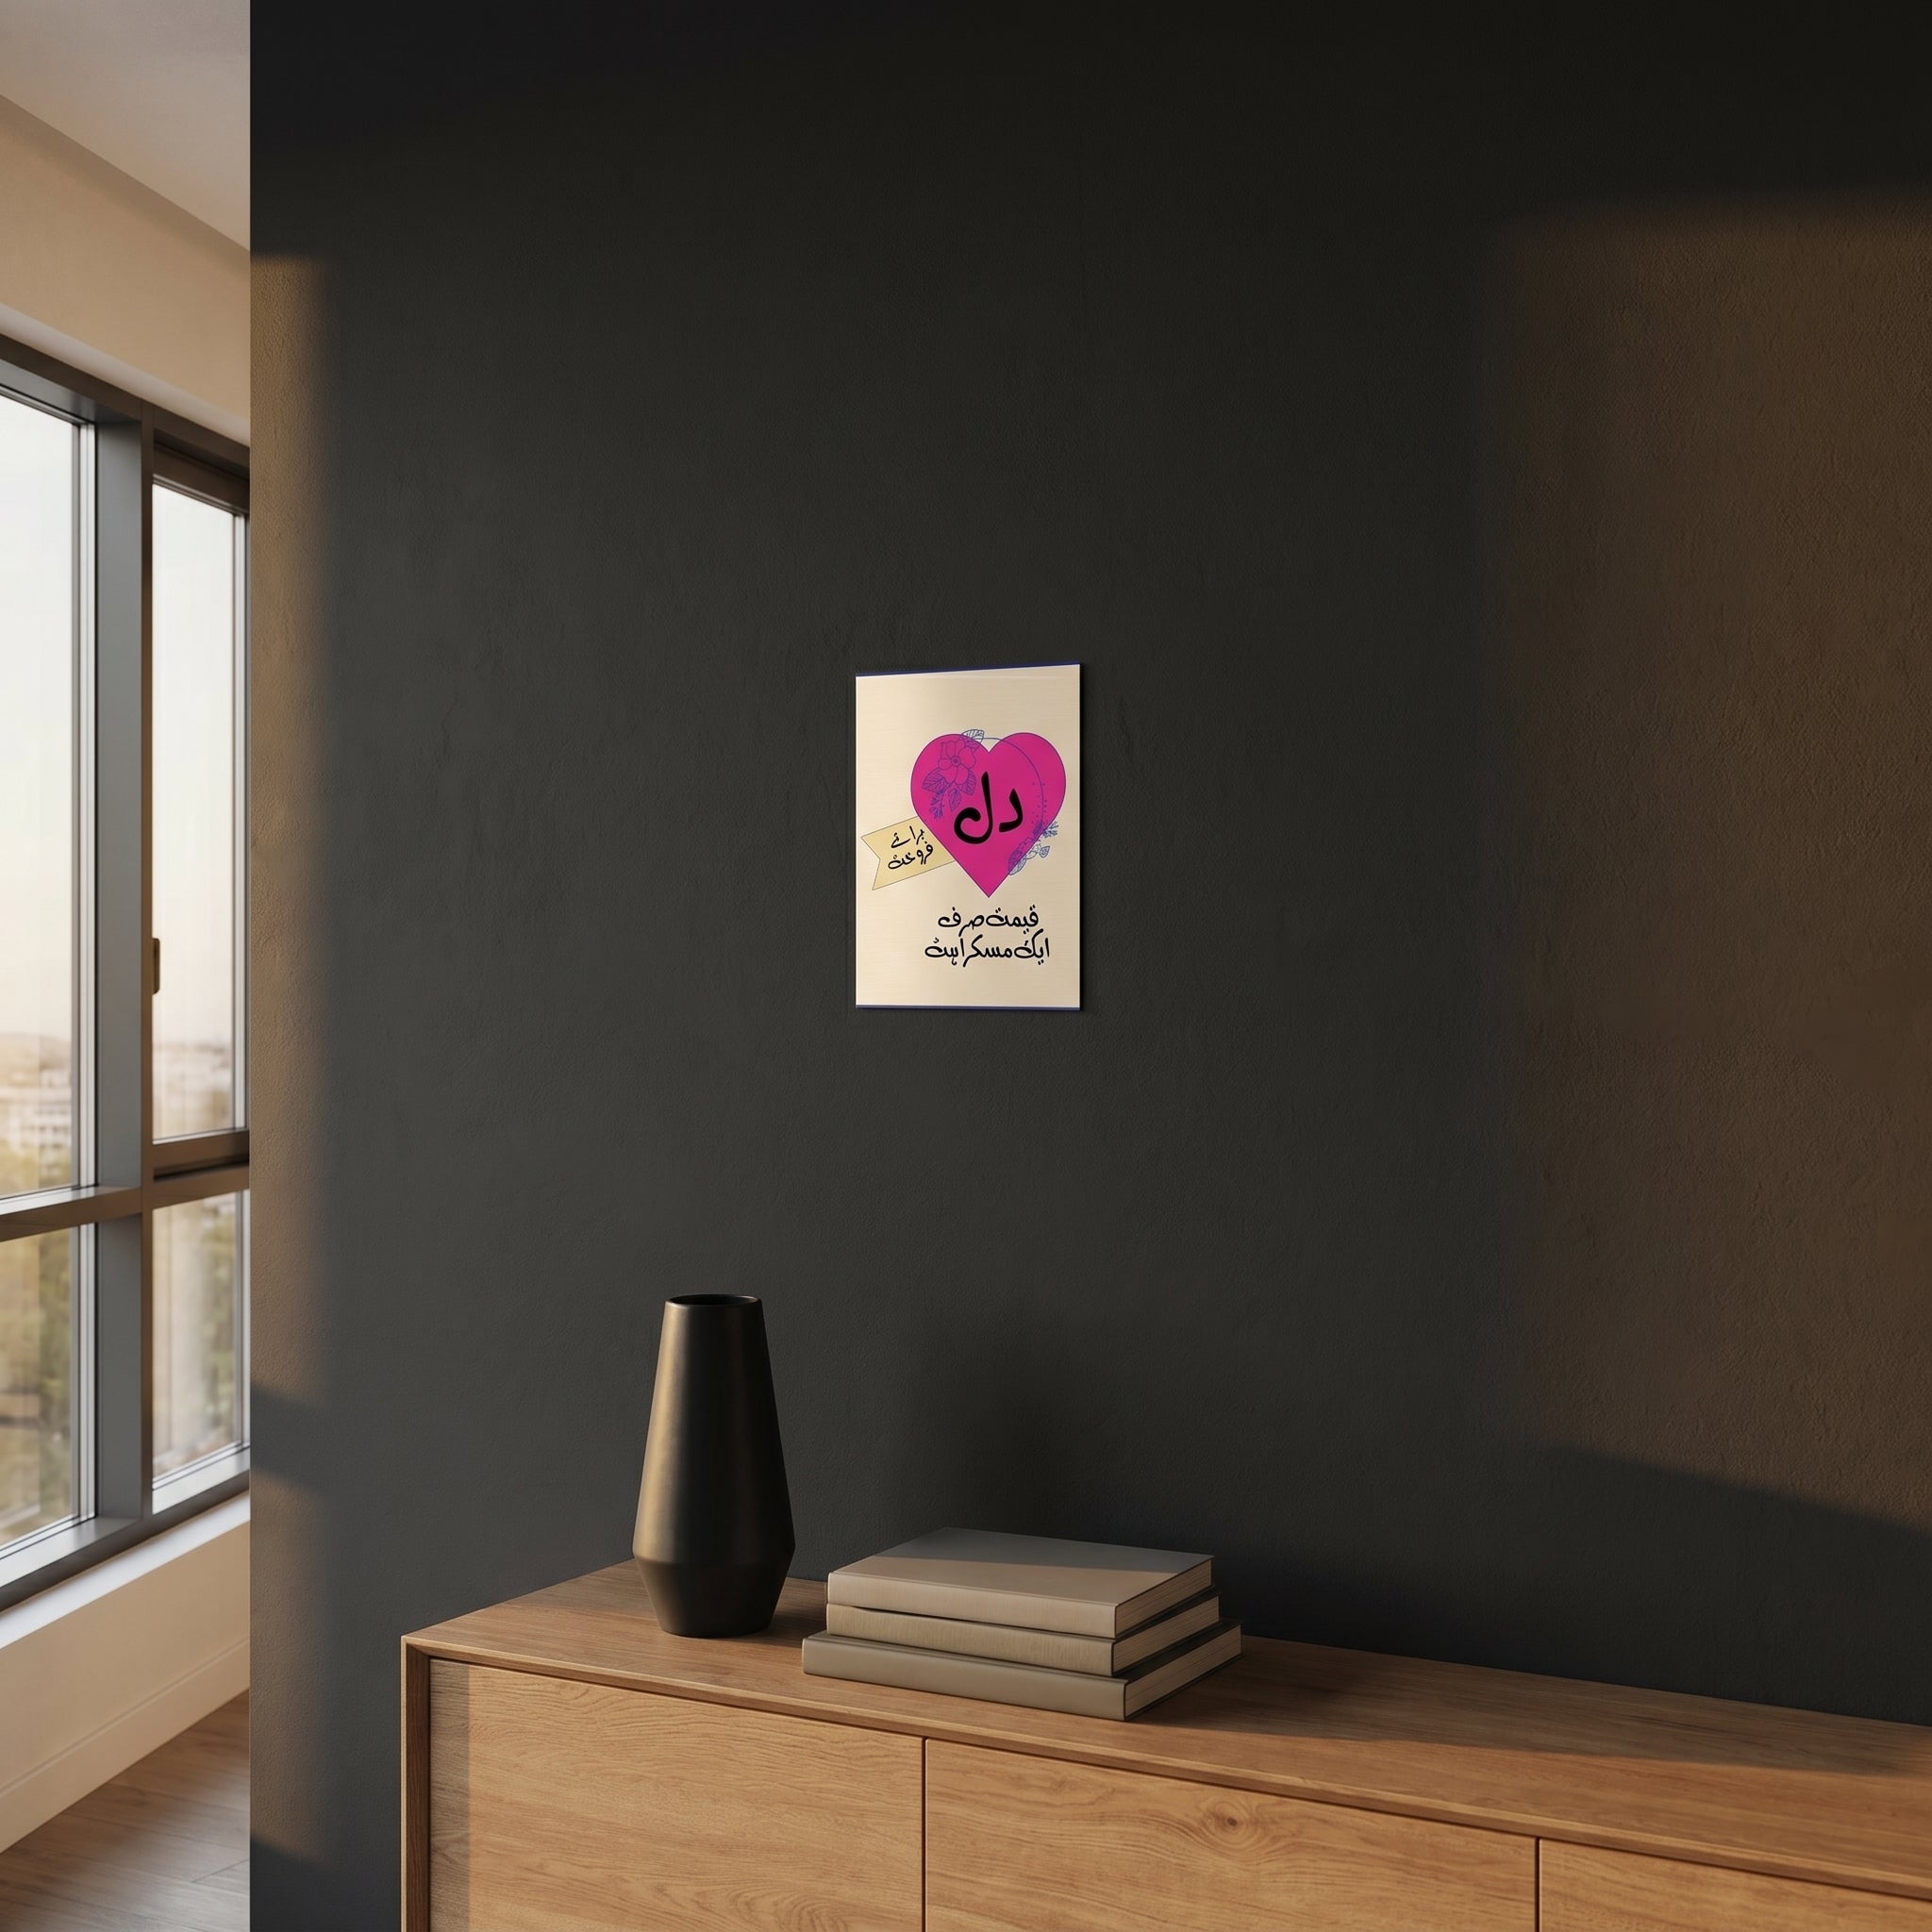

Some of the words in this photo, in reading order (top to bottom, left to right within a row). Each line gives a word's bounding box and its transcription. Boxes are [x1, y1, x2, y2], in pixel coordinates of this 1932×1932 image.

[954, 771, 1024, 844] دل
[891, 825, 925, 849] برائے
[888, 841, 934, 870] فروخت
[938, 906, 985, 938] صرف
[986, 904, 1040, 935] قیمت
[924, 934, 1013, 967] مسکراہٹ
[1014, 928, 1050, 965] ایک
